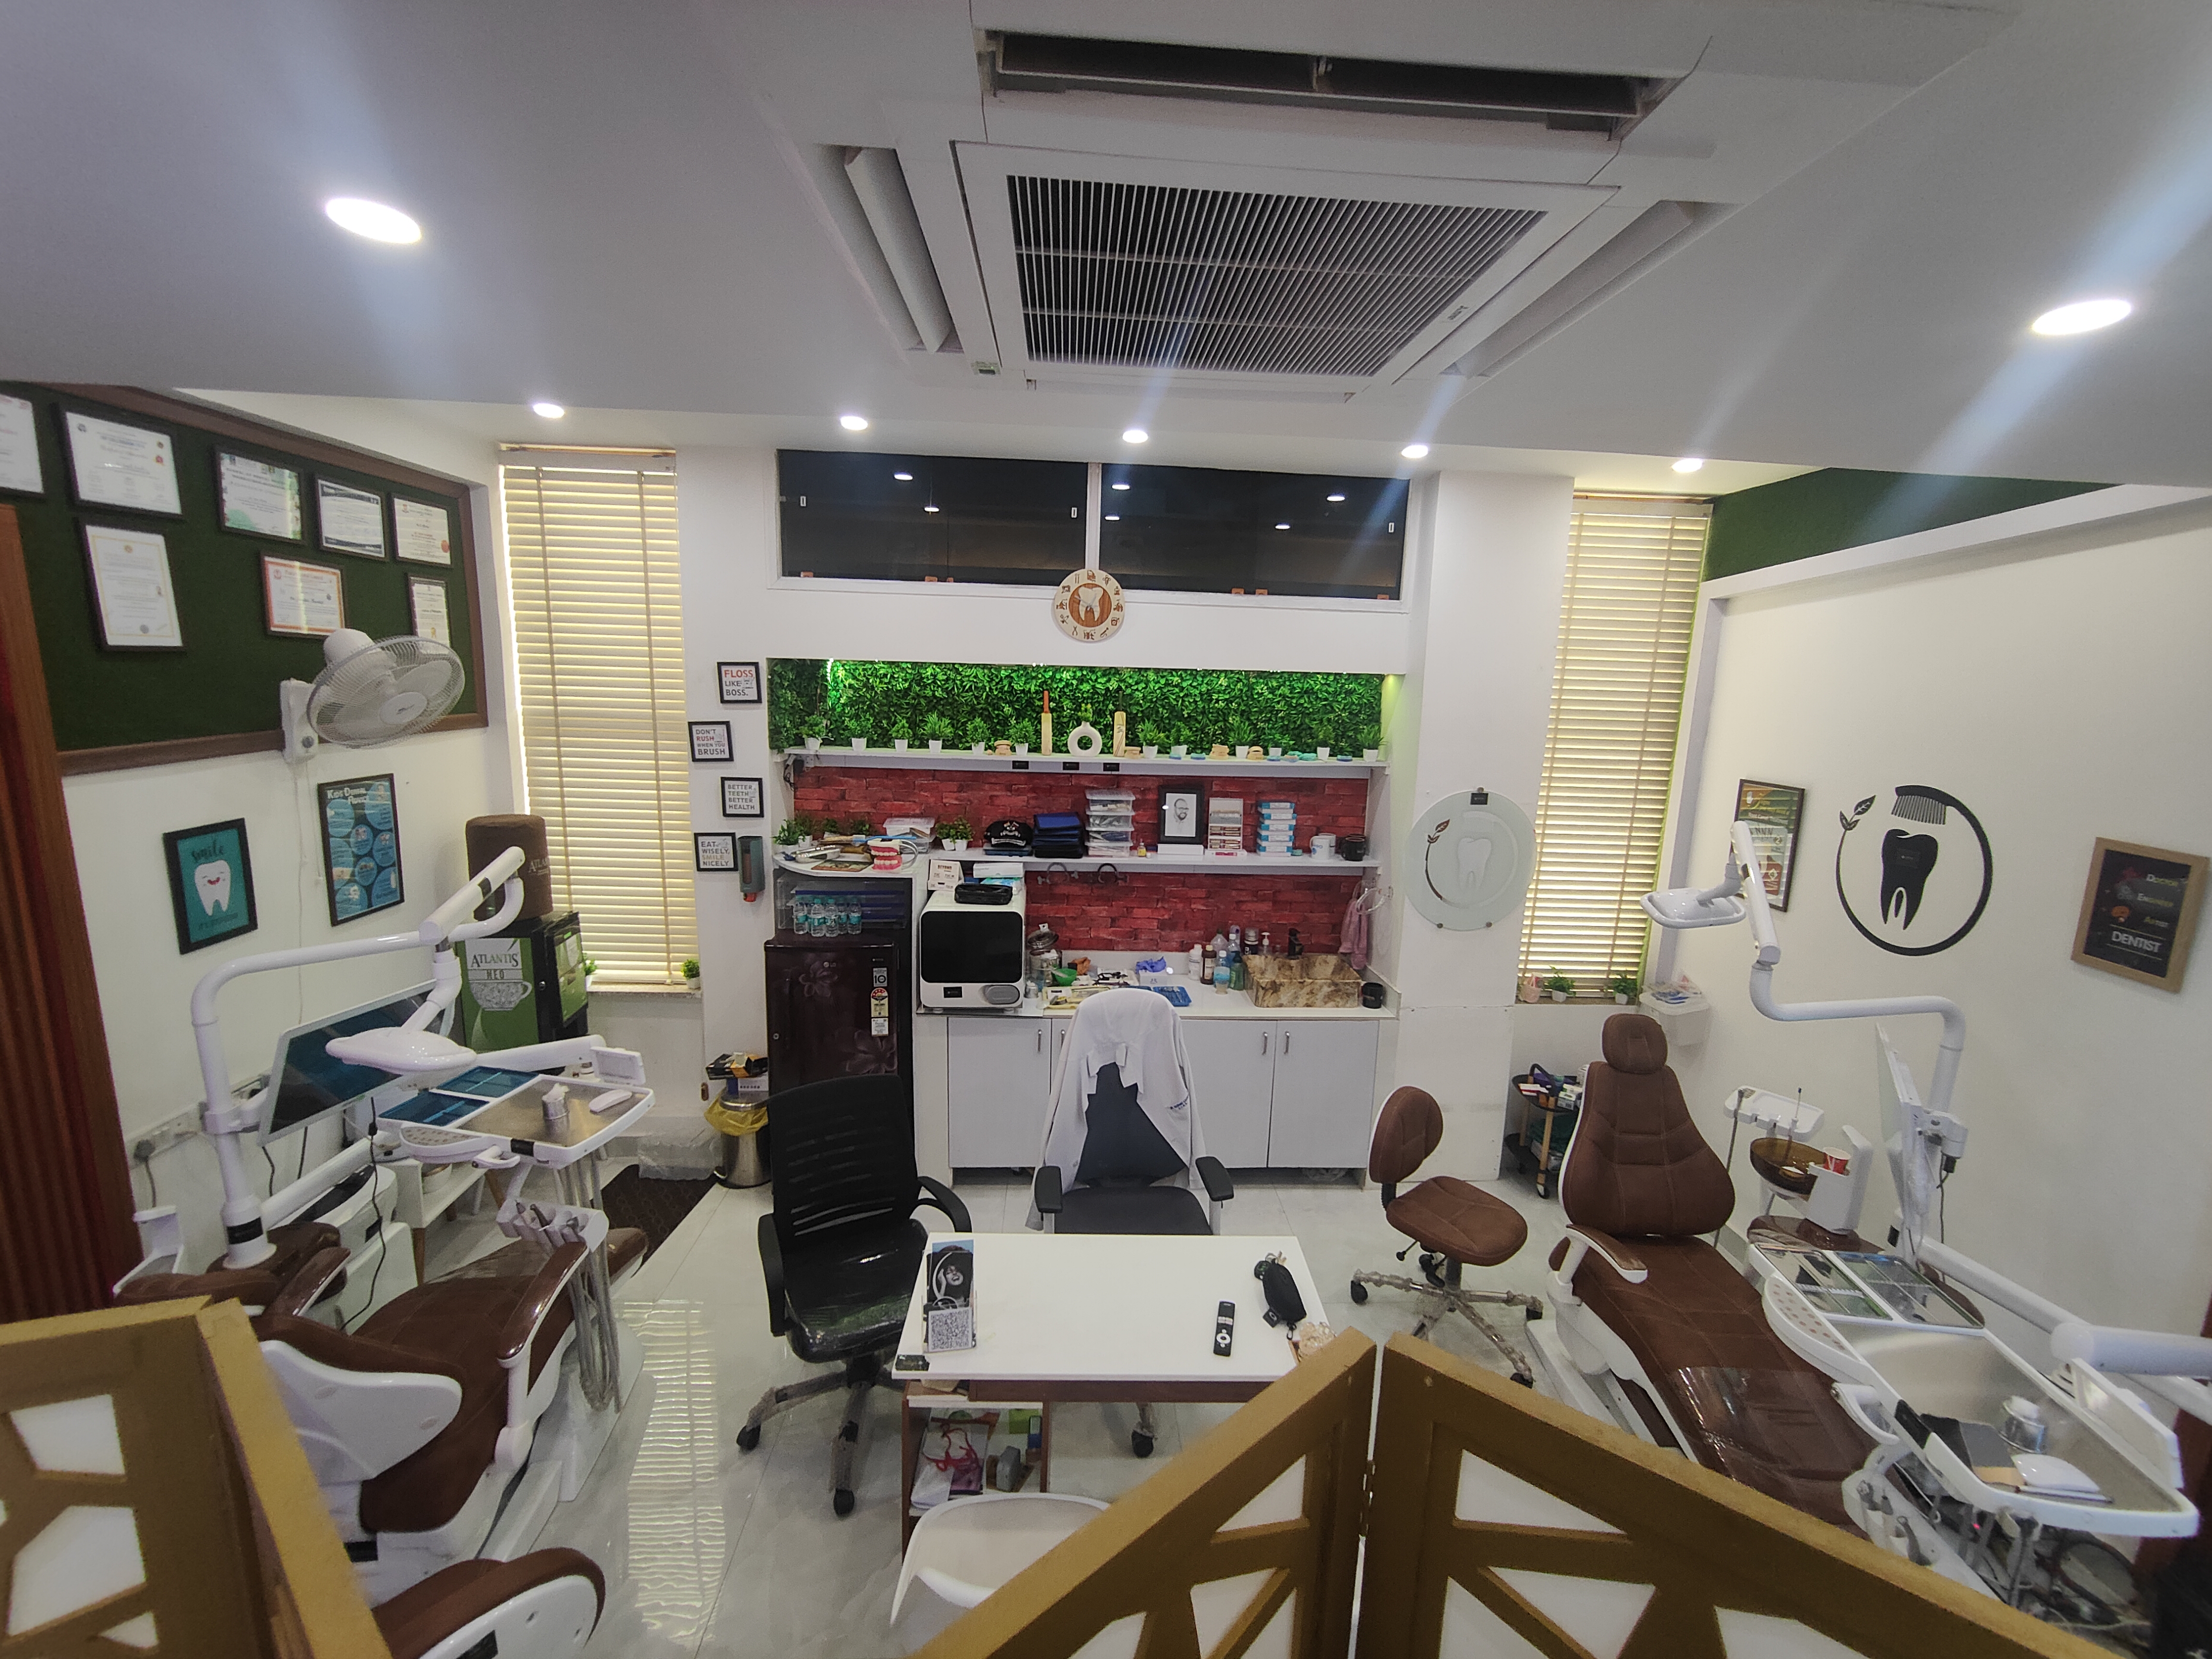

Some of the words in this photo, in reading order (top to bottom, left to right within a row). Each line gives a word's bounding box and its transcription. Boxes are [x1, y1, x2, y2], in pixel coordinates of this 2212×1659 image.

[724, 669, 753, 678] FLOSS
[2112, 931, 2162, 952] DENTIST
[470, 953, 519, 967] ATLANTIS
[487, 970, 505, 980] NEO
